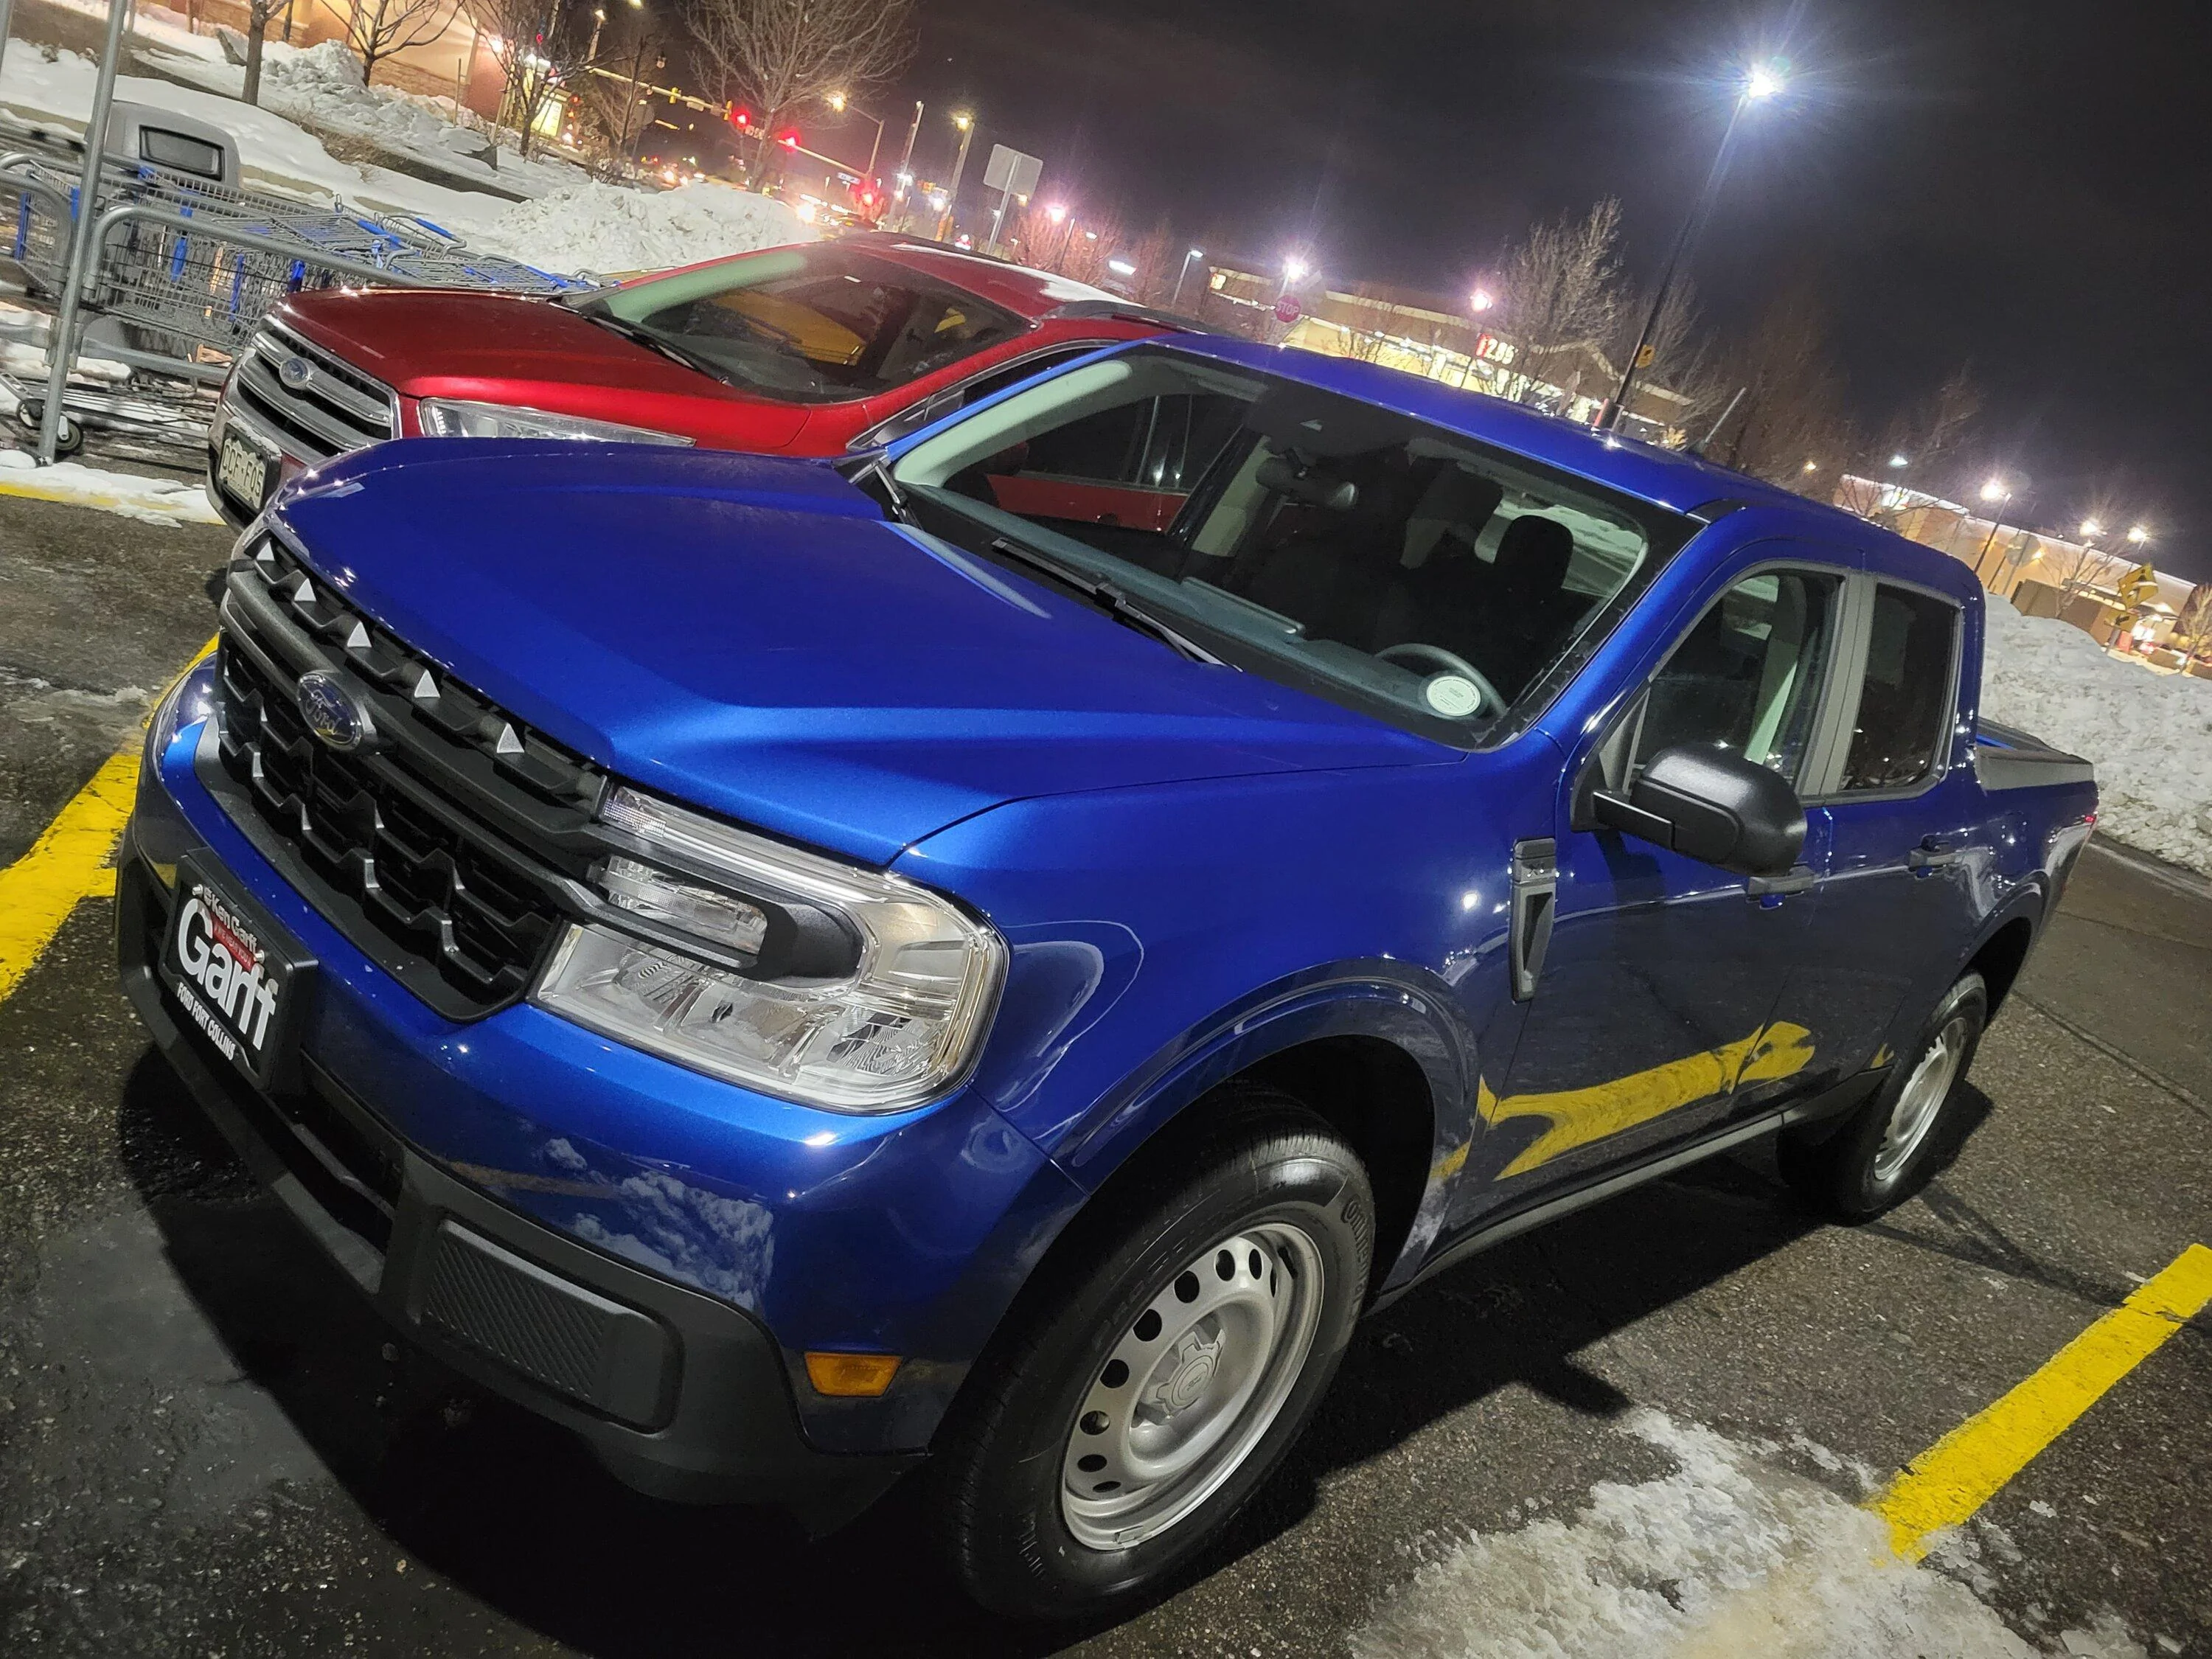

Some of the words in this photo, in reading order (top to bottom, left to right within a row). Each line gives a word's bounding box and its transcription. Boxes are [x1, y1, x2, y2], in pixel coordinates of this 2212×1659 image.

[1276, 300, 1299, 316] STOP
[212, 893, 231, 929] Ken
[178, 898, 279, 1051] Garff
[177, 981, 194, 1011] FORD
[192, 1000, 210, 1030] FORT
[207, 1019, 236, 1060] COLLINS
